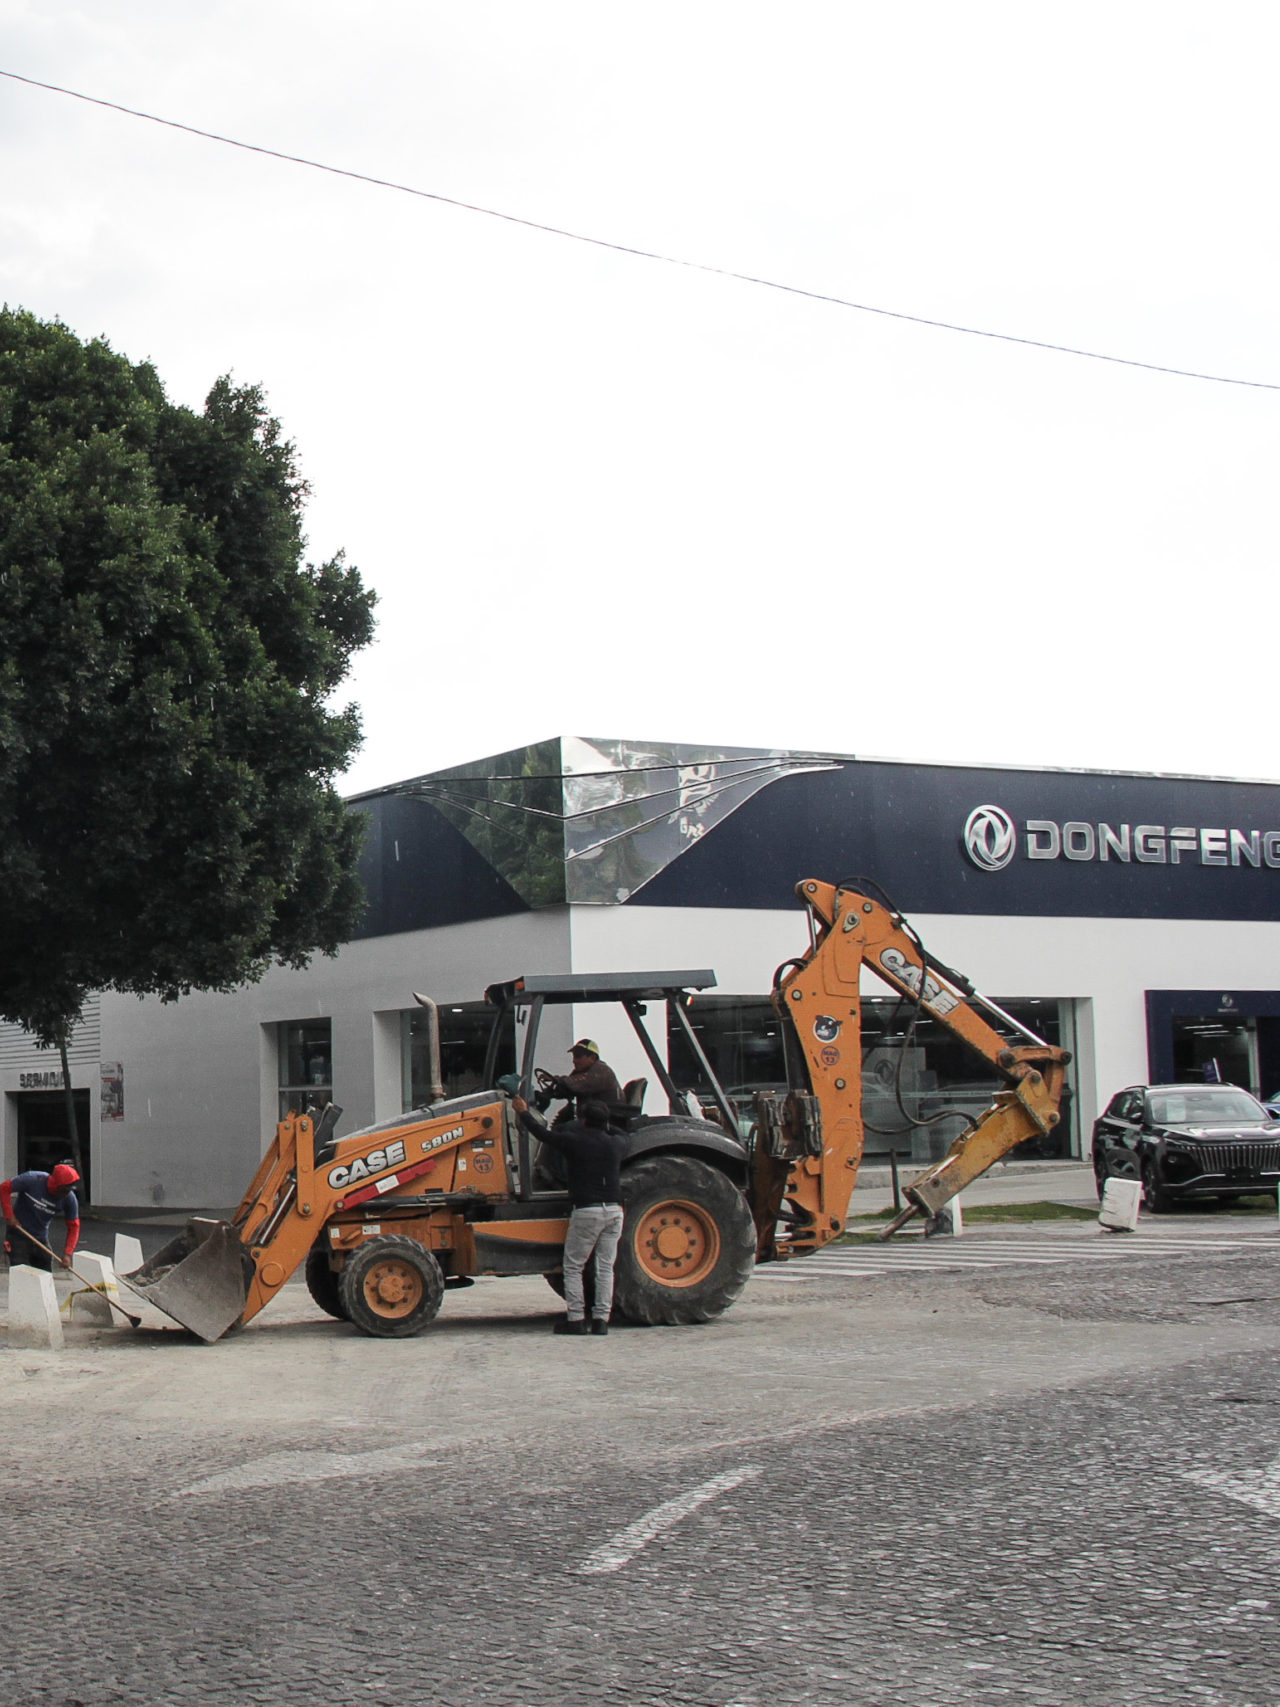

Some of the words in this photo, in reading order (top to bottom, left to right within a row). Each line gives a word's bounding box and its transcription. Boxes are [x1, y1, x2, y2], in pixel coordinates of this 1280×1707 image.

[880, 947, 960, 1016] CASE
[20, 1071, 70, 1088] SERVICI
[328, 1140, 406, 1189] CASE
[420, 1126, 464, 1153] 580N
